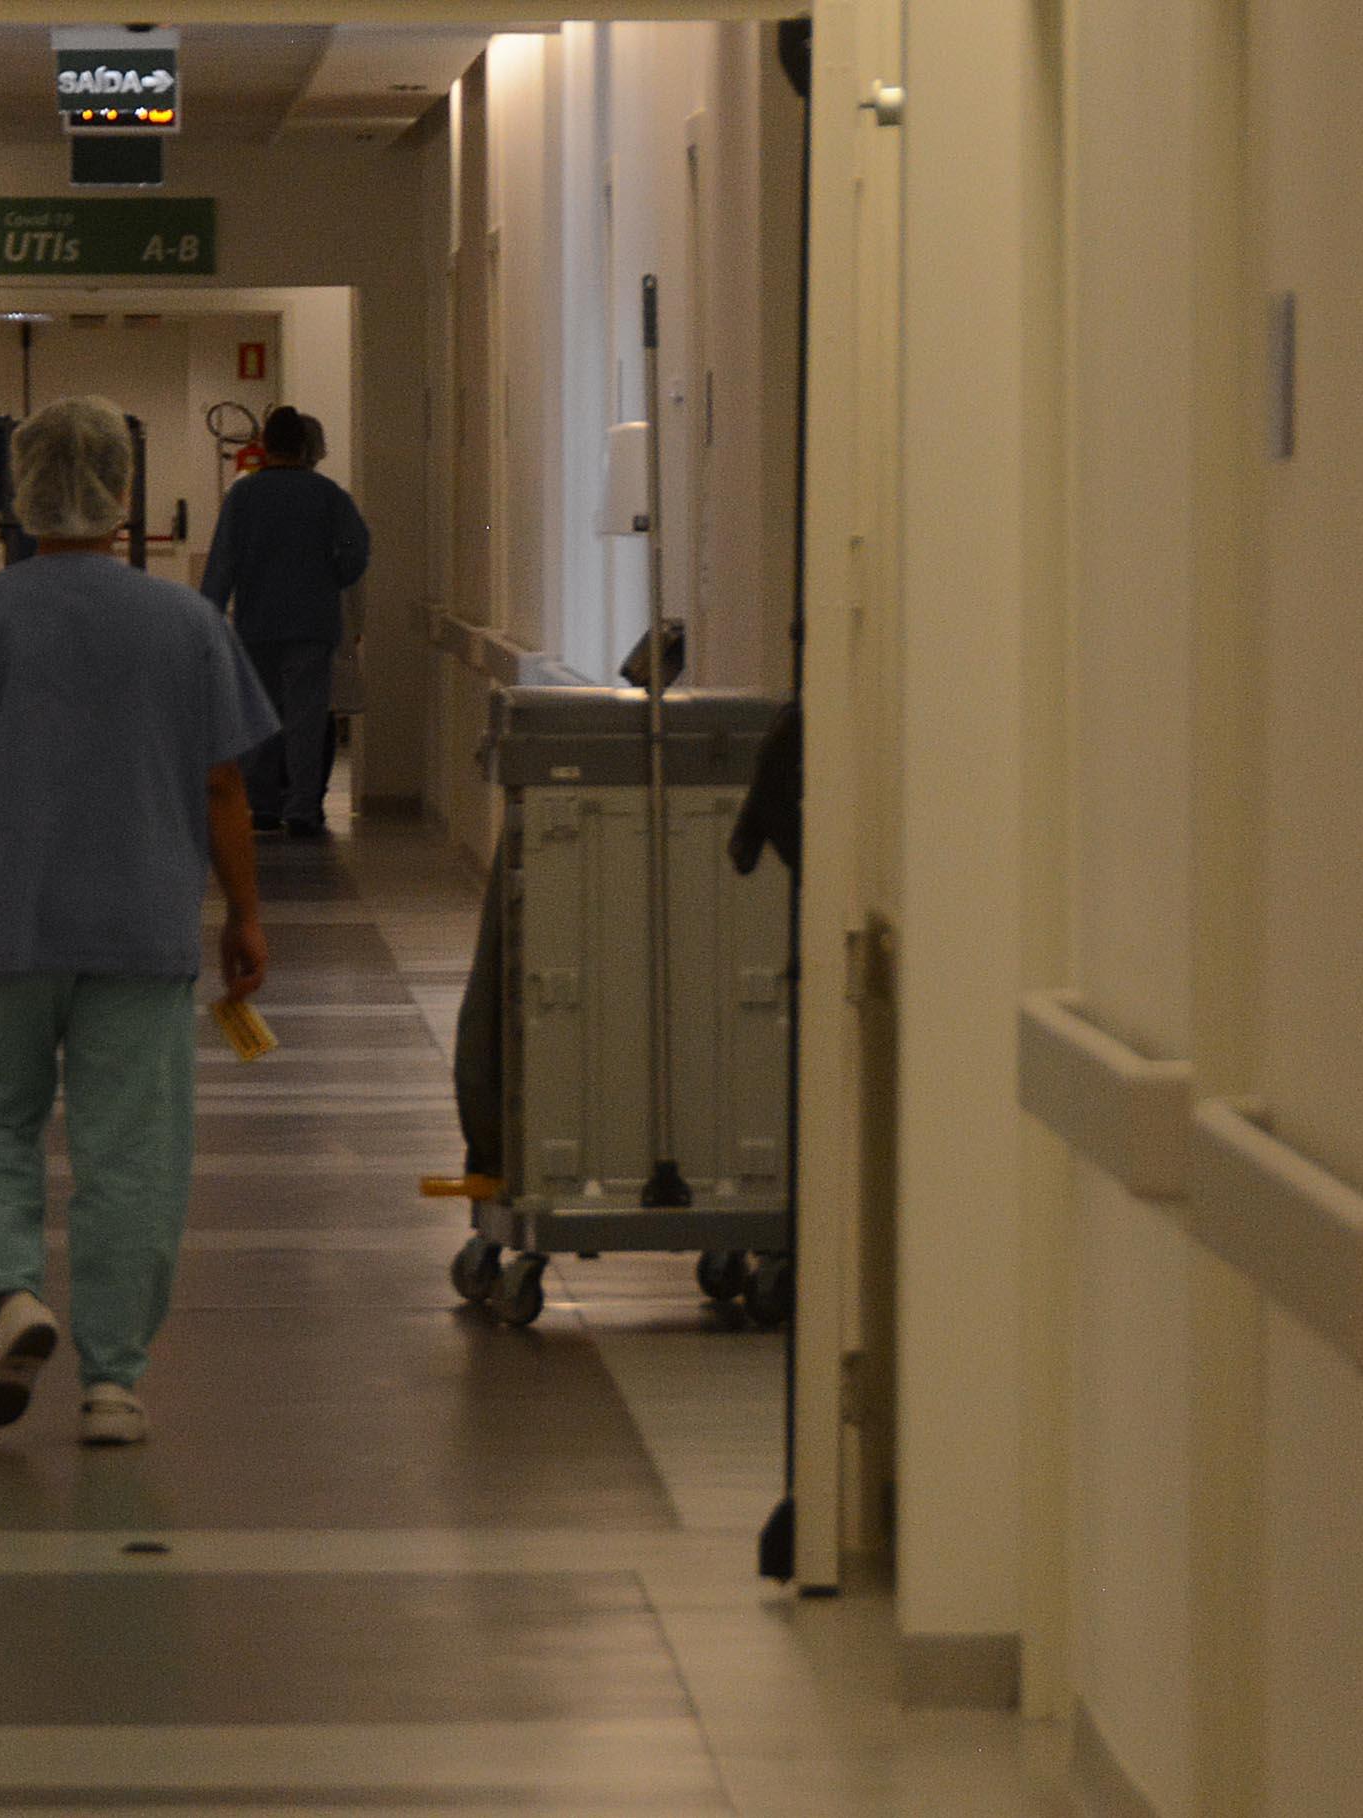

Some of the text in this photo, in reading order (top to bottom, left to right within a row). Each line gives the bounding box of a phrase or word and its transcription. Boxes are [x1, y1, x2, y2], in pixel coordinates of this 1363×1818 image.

[58, 65, 142, 94] SAÍDA
[4, 231, 200, 262] UTIs A-B
